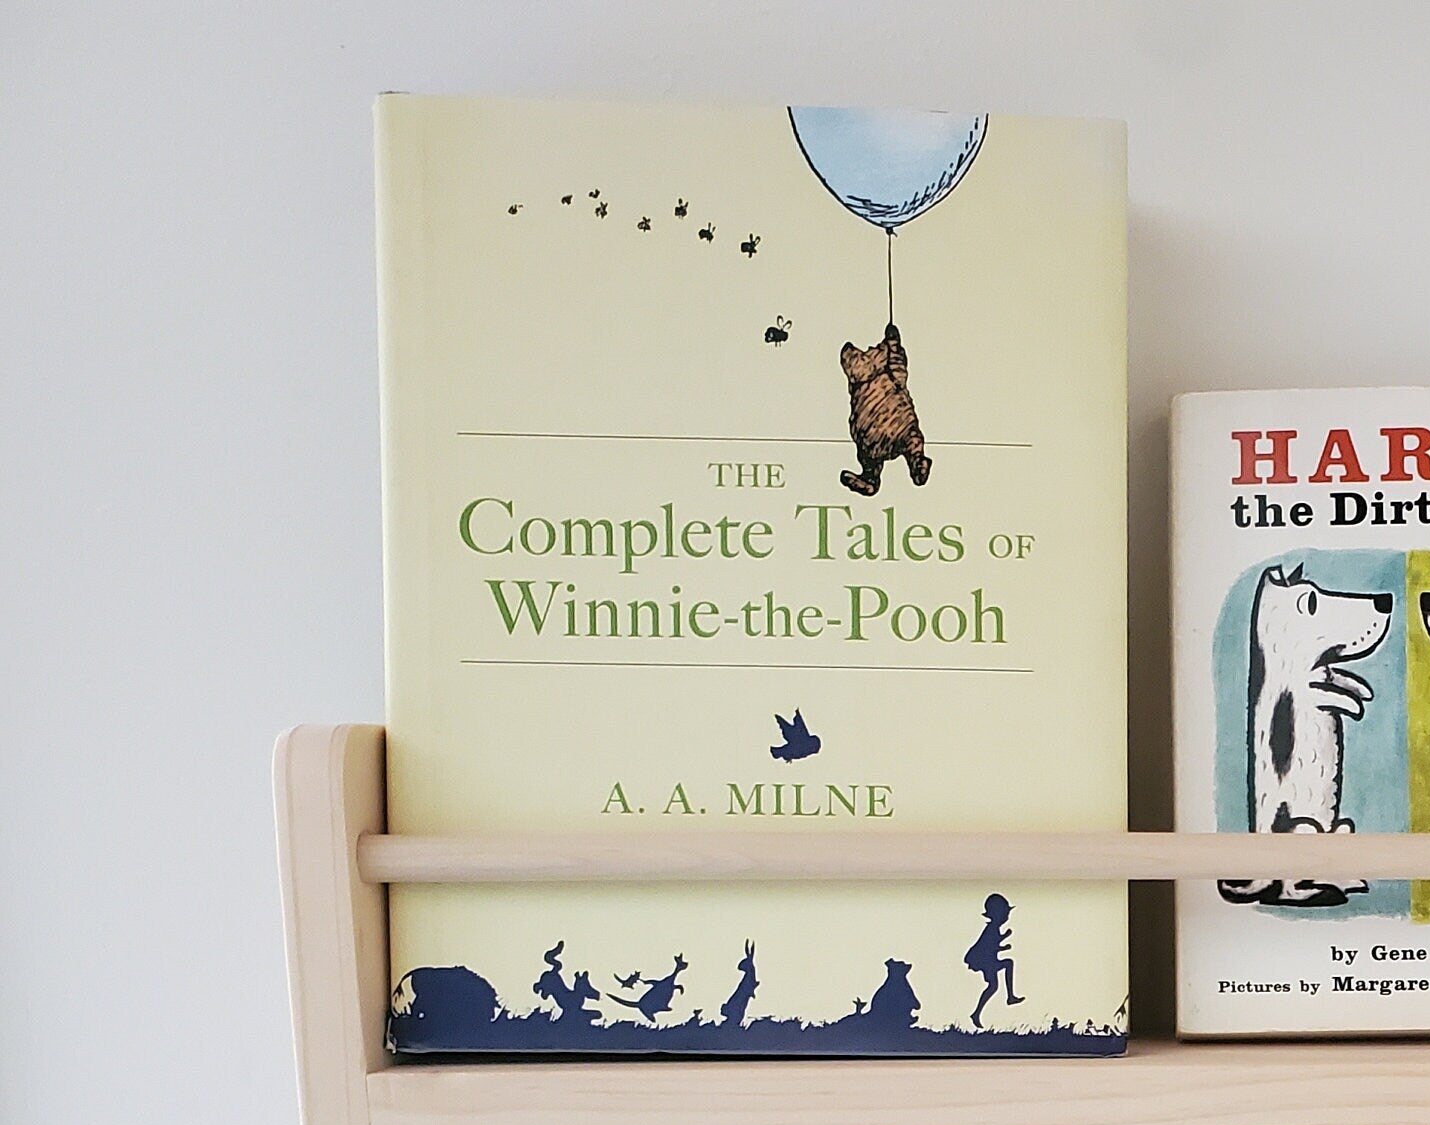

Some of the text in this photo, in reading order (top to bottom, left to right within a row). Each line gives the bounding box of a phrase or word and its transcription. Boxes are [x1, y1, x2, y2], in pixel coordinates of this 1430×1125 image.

[707, 462, 786, 488] THE
[1230, 494, 1314, 528] the
[459, 497, 1036, 575] Complete Tales OF
[483, 579, 1007, 644] Winnie-the-Pooh
[600, 782, 894, 818] A. A. MILNE
[1330, 945, 1358, 966] by
[1371, 945, 1427, 961] Gene
[1218, 980, 1291, 994] Pictures
[1299, 979, 1321, 996] by
